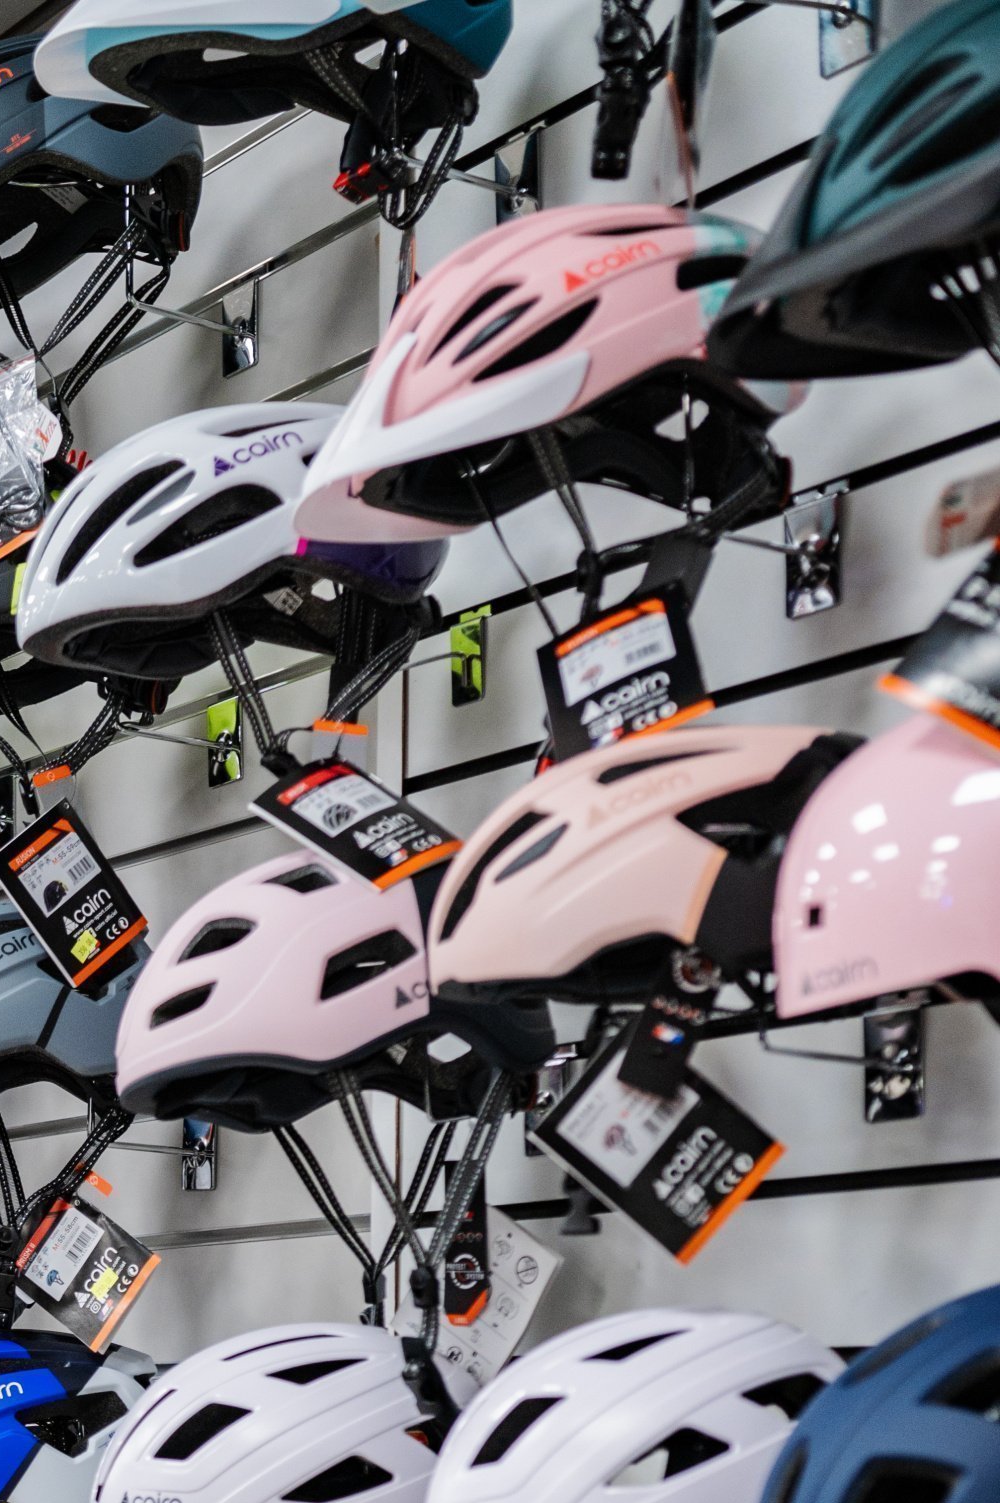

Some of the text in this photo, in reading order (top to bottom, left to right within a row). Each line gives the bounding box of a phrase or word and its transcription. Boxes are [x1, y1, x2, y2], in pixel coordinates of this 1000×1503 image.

[585, 237, 662, 283] cairn
[233, 430, 304, 465] cairn
[601, 671, 671, 712] cairn
[15, 846, 36, 866] FUSION
[73, 888, 112, 924] cairn
